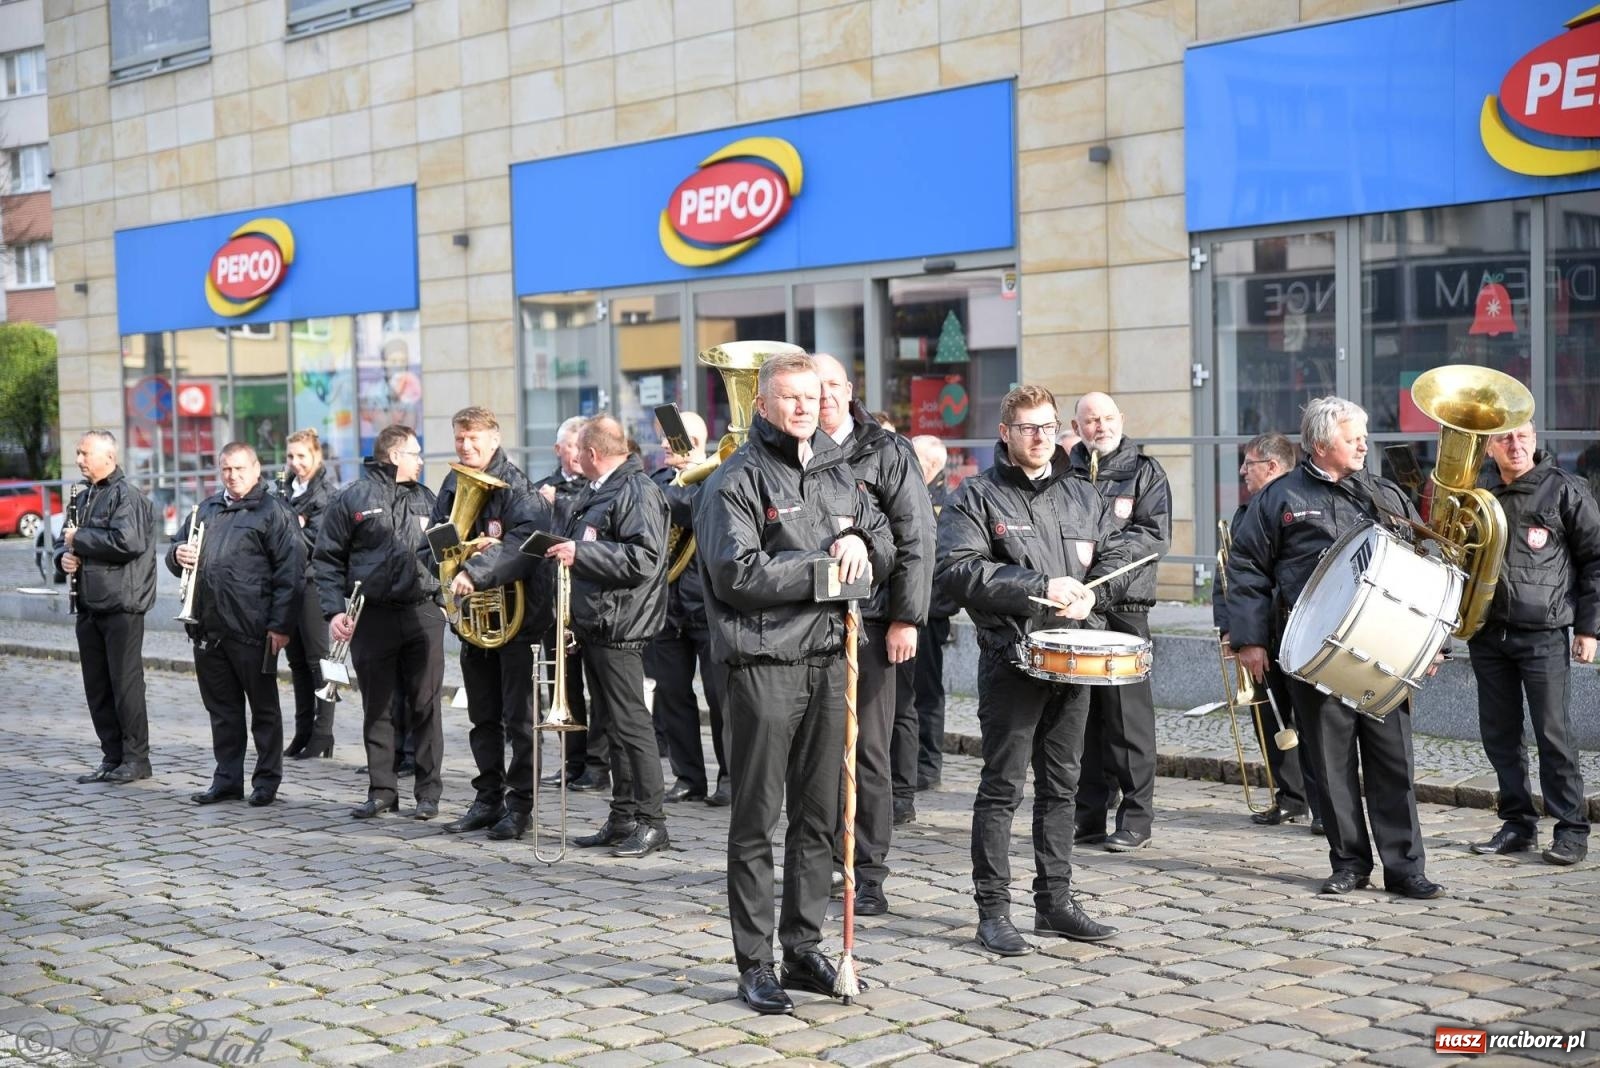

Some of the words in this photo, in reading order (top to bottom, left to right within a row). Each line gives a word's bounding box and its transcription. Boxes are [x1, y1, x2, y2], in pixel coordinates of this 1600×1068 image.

[1525, 54, 1600, 116] PE
[679, 178, 774, 226] PEPCO
[216, 248, 276, 285] PEPCO
